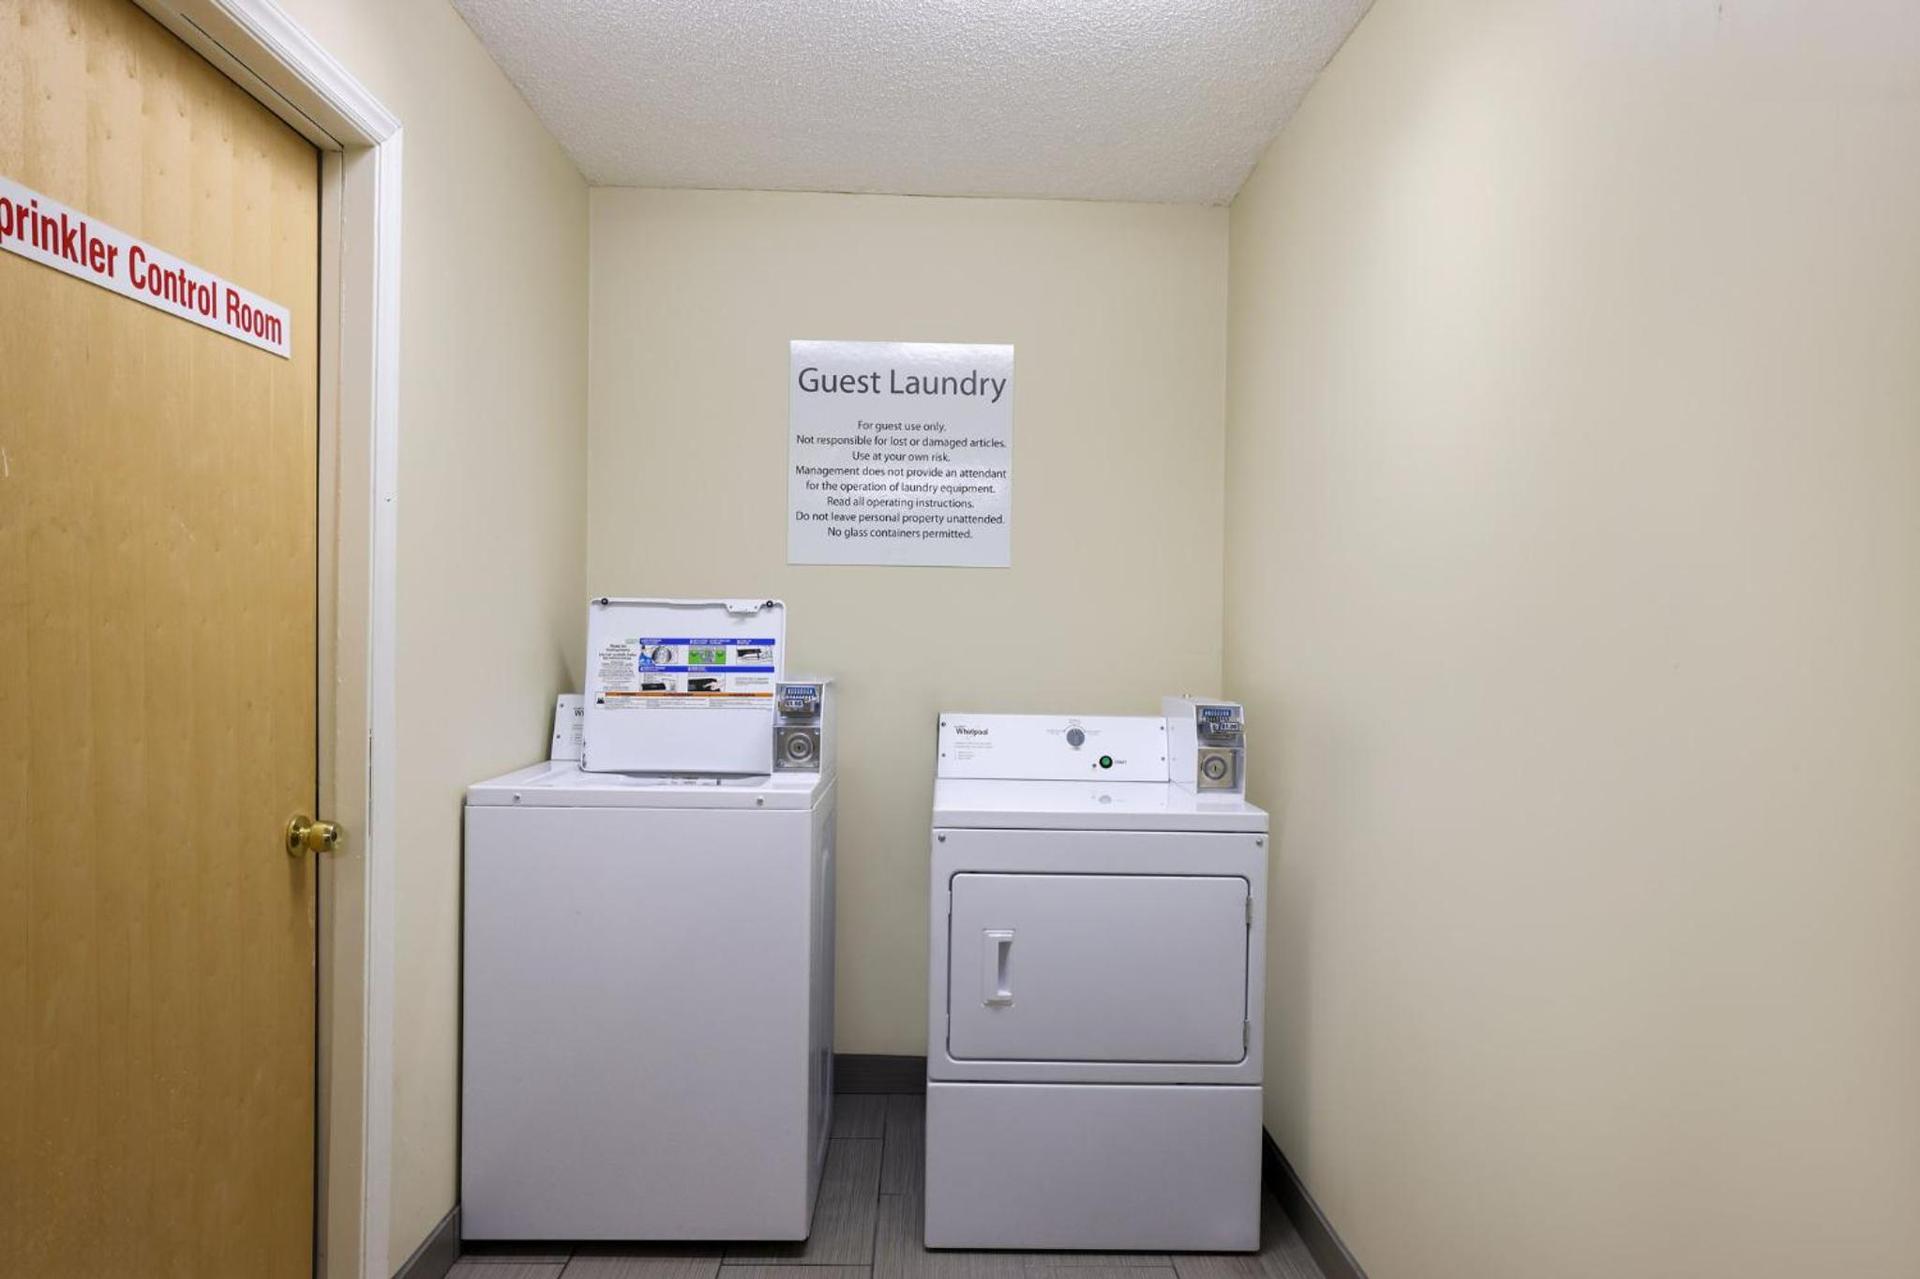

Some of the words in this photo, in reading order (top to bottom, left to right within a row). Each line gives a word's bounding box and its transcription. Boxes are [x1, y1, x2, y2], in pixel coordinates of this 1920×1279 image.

[129, 245, 217, 319] Control
[226, 288, 282, 345] Room
[798, 367, 880, 394] Guest
[890, 369, 1006, 403] Laundry
[858, 421, 873, 430] For
[875, 422, 902, 432] guest
[923, 422, 946, 432] only.
[797, 436, 814, 444] Not
[816, 436, 872, 446] responsible
[874, 437, 888, 446] for
[890, 437, 908, 446] lost
[922, 438, 968, 449] damaged
[970, 438, 1006, 448] articles.
[852, 452, 870, 461] Use
[884, 454, 906, 463] your
[932, 452, 950, 462] risk.
[796, 466, 860, 478] Management
[862, 467, 885, 477] does
[888, 468, 904, 477] not
[906, 468, 944, 479] provide
[960, 469, 1006, 478] attendant
[806, 481, 820, 490] for
[822, 482, 838, 491] the
[840, 482, 887, 493] operation
[889, 482, 899, 491] of
[901, 482, 938, 494] laundry
[940, 484, 995, 494] equipment.
[827, 497, 851, 506] Read
[853, 497, 864, 506] all
[866, 498, 914, 509] operating
[916, 498, 974, 508] instructions.
[796, 512, 810, 521] Do
[812, 513, 829, 521] not
[831, 513, 856, 522] leave
[859, 513, 900, 524] personal
[902, 515, 944, 525] property
[946, 514, 1005, 524] unattended.
[828, 528, 842, 537] No
[844, 528, 868, 539] glass
[870, 529, 921, 538] containers
[922, 529, 973, 540] permitted.
[956, 728, 989, 738] Whirlpool
